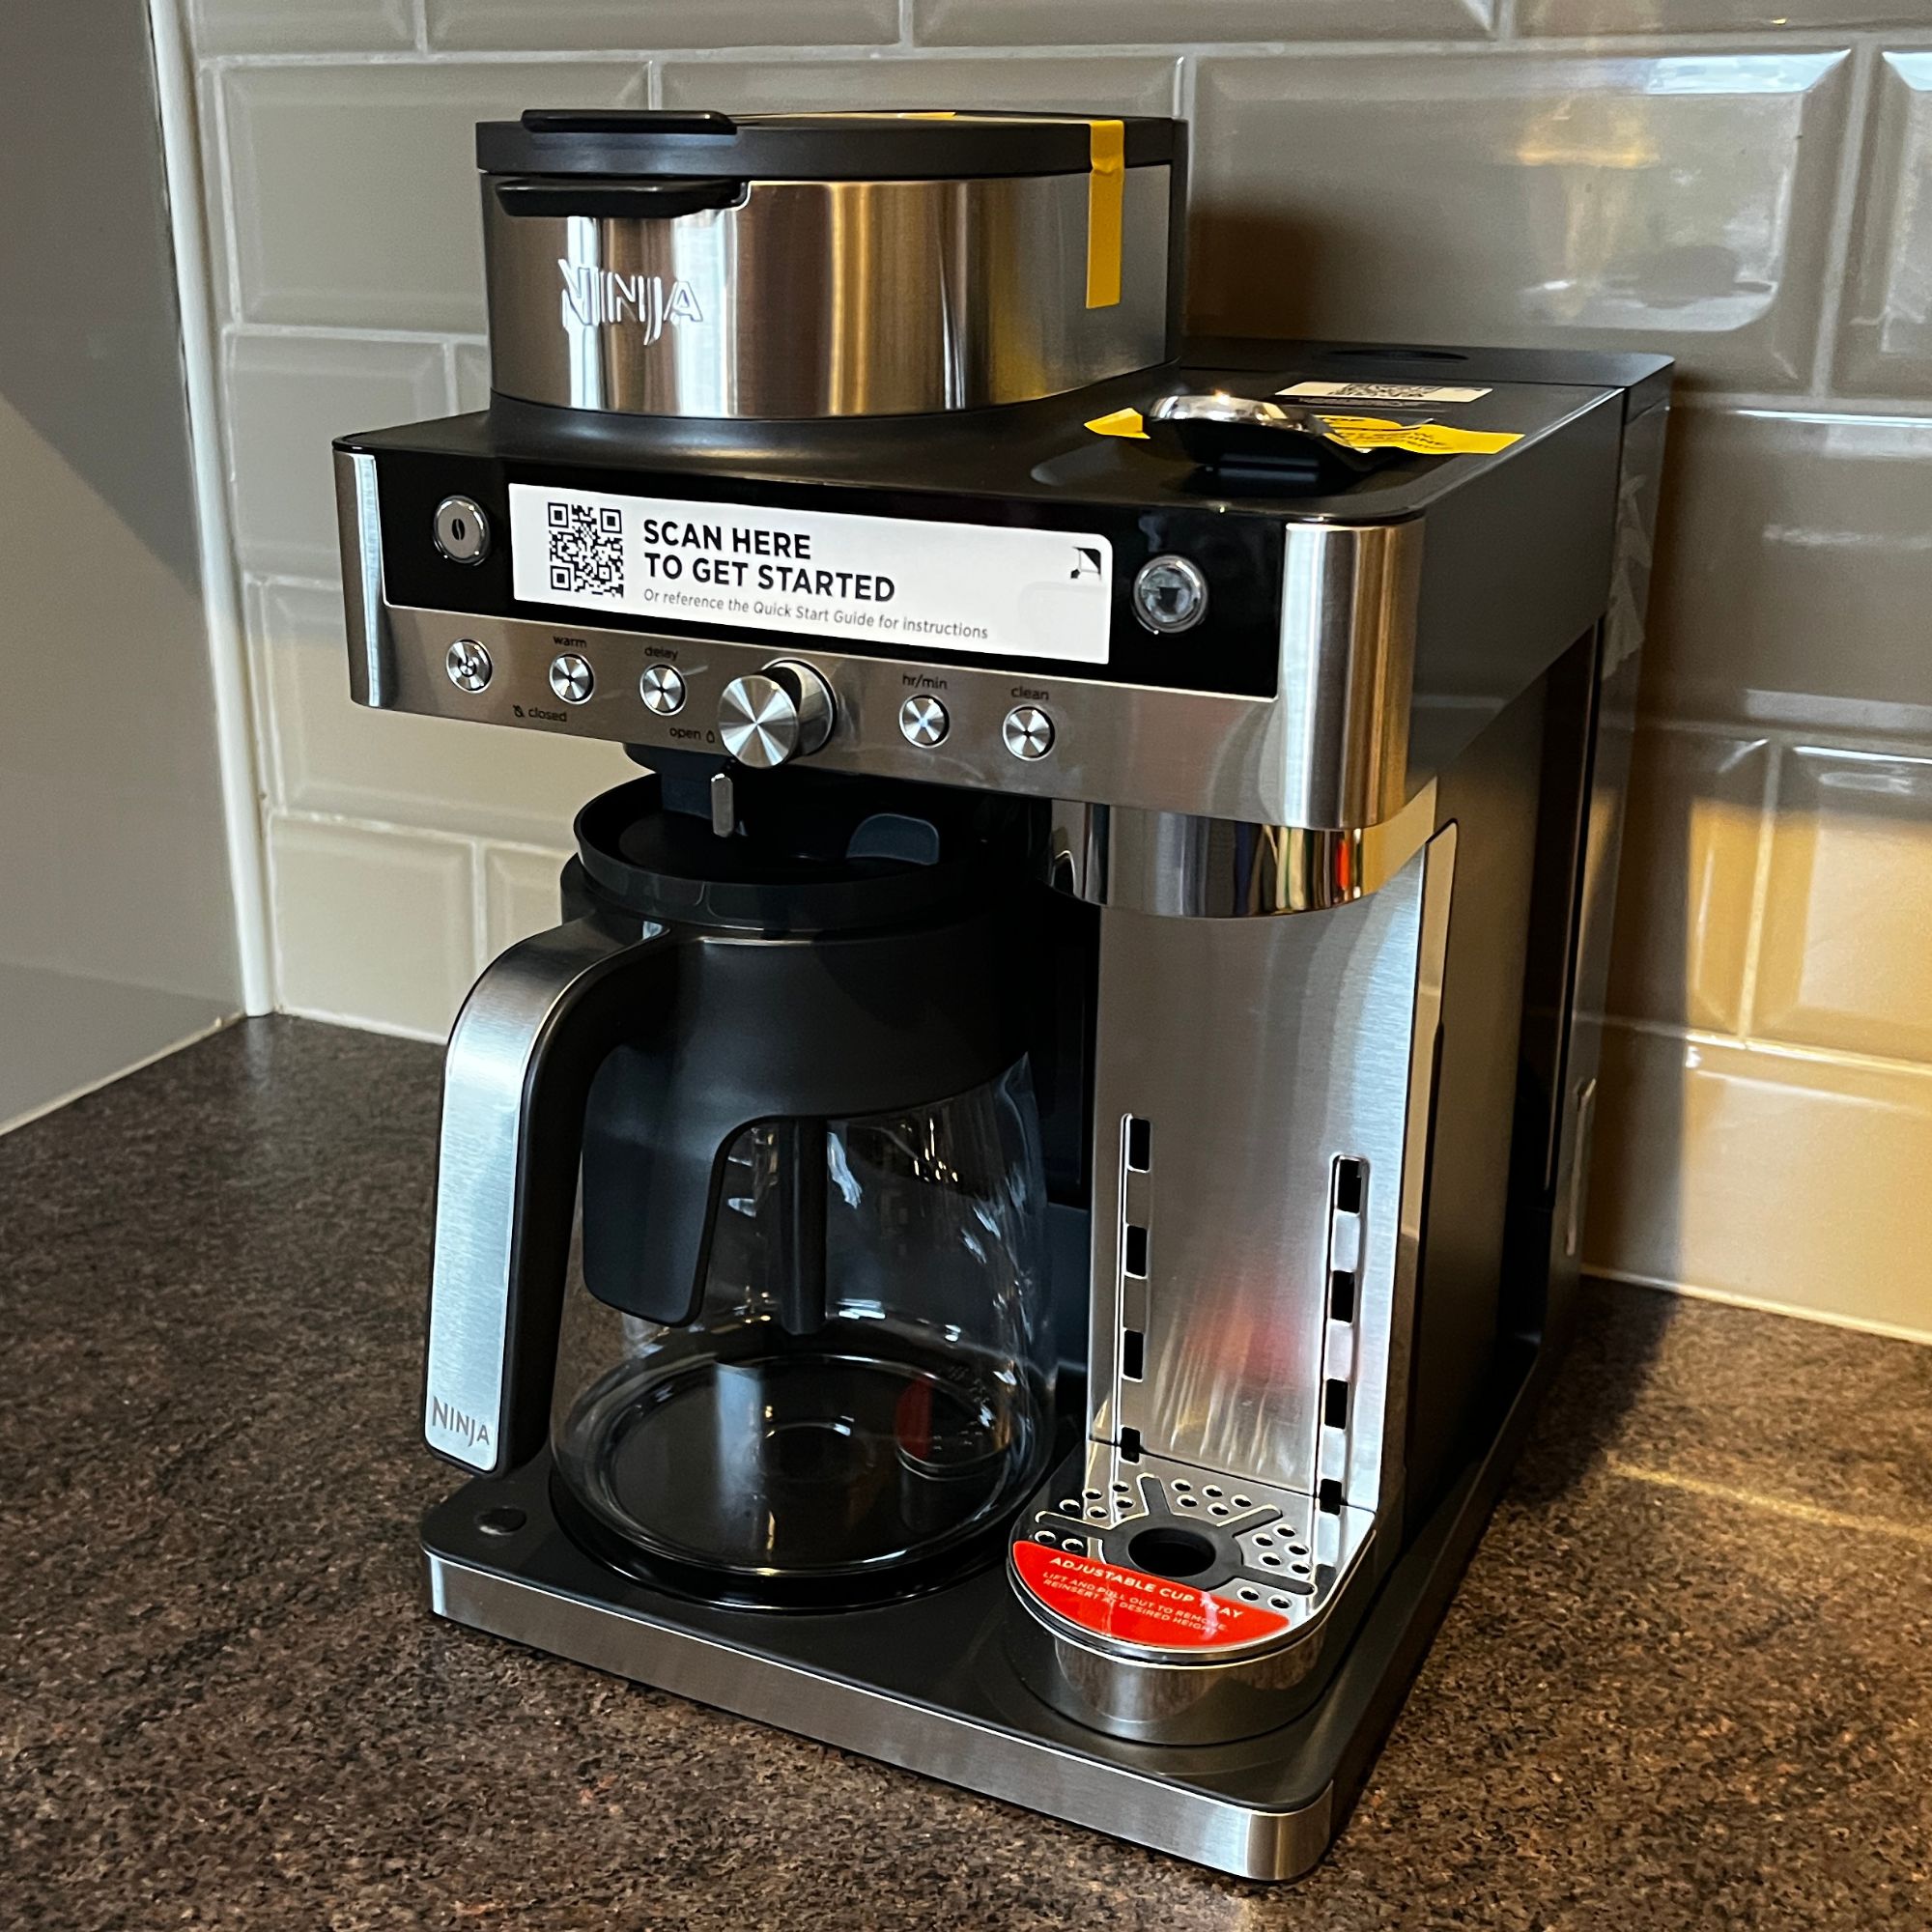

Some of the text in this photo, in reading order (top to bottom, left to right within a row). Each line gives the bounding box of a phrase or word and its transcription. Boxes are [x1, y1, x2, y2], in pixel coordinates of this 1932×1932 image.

[557, 258, 703, 346] NINJA
[643, 519, 811, 560] SCAN HERE
[643, 552, 895, 603] TO GET STARTED
[643, 588, 988, 639] Or reference the Quick Start Guide for instructions
[554, 635, 587, 648] warm
[644, 645, 678, 662] delay
[902, 673, 948, 690] hr/min
[1010, 686, 1049, 700] clean
[528, 707, 568, 723] closed
[669, 725, 702, 742] open
[432, 1395, 490, 1447] NINJA
[1042, 1572, 1068, 1582] LIFT
[1069, 1579, 1095, 1591] AND
[1129, 1597, 1155, 1608] OUT
[1158, 1605, 1174, 1614] TO
[1043, 1578, 1099, 1600] REINSERT
[1119, 1602, 1171, 1622] DESIRED
[1049, 1557, 1157, 1592] ADJUSTABLE
[1159, 1587, 1196, 1603] CUP
